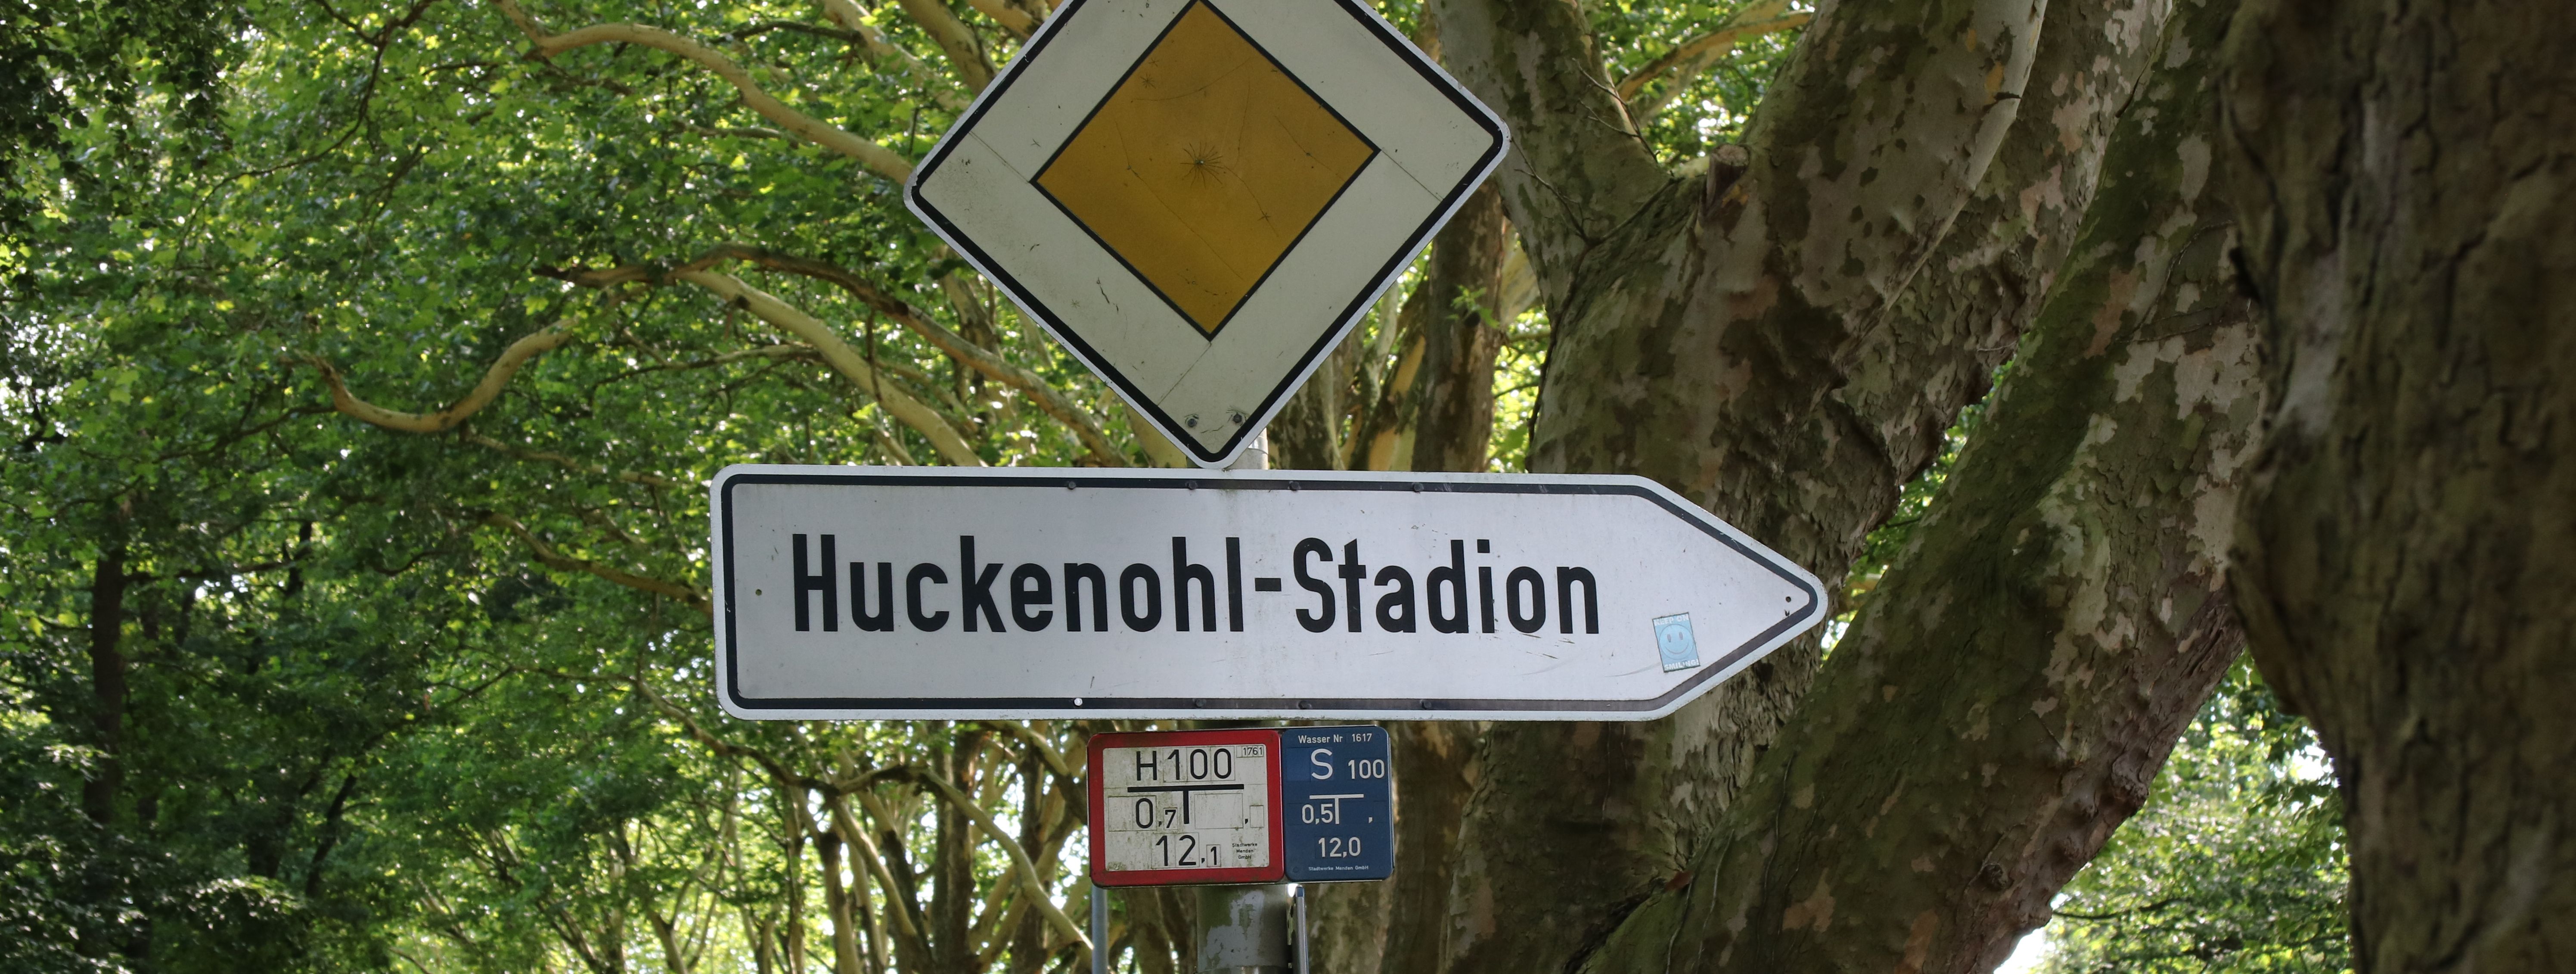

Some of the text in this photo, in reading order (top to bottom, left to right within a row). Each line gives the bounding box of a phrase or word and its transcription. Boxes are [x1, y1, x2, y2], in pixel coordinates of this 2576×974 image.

[792, 533, 1599, 634] Huckenohl-Stadion
[1654, 613, 1689, 626] KEEP ON
[1664, 659, 1699, 670] SMILING!
[1298, 733, 1372, 744] Wasser Nr 1617
[1243, 747, 1263, 756] 1761
[1136, 748, 1232, 781] H100
[1311, 748, 1384, 779] S 100
[1136, 798, 1176, 829] 0,7
[1302, 804, 1333, 825] 0,5
[1155, 835, 1217, 866] 12,1
[1318, 837, 1361, 858] 12,0
